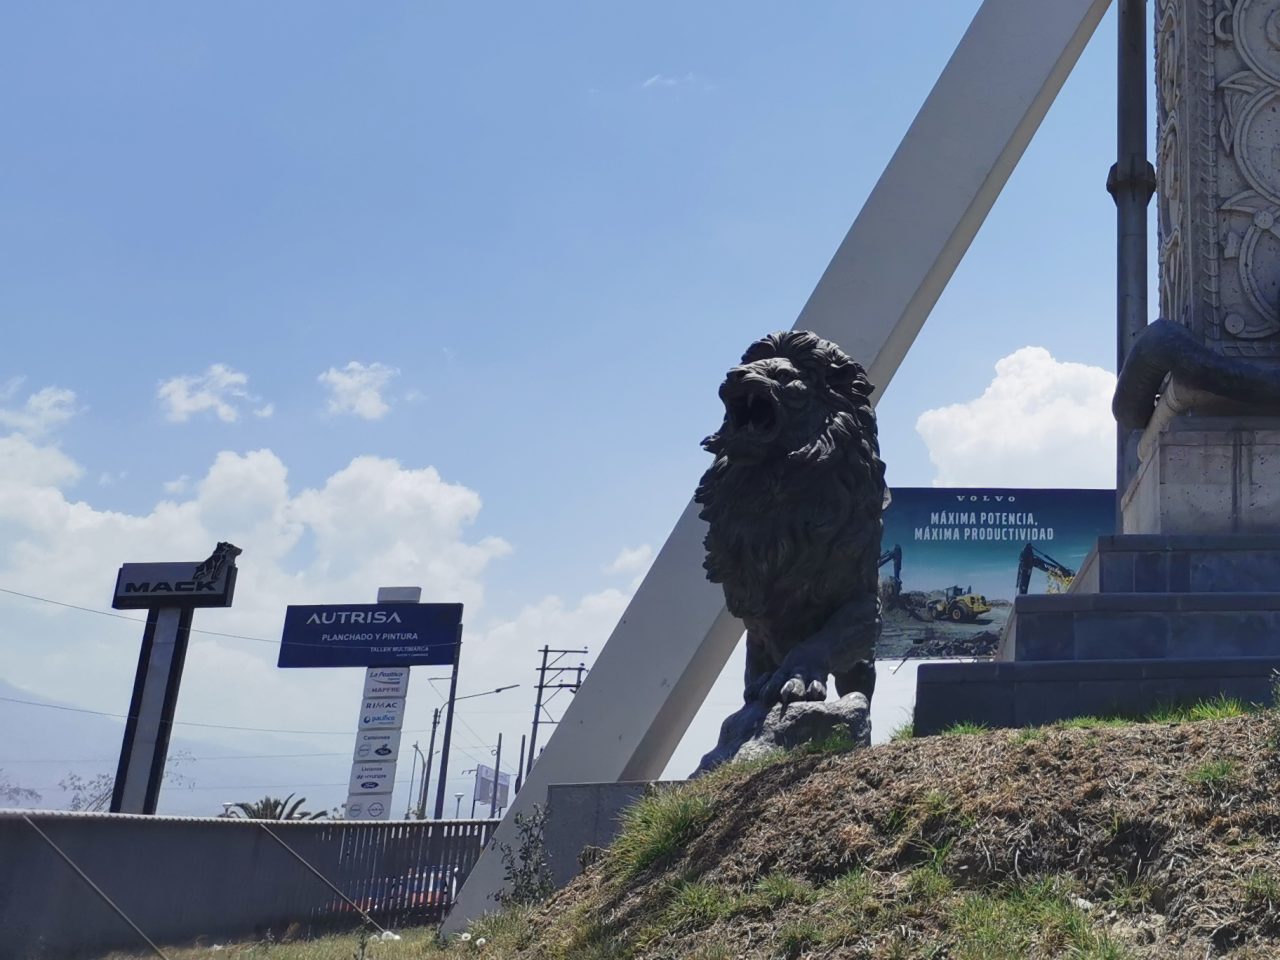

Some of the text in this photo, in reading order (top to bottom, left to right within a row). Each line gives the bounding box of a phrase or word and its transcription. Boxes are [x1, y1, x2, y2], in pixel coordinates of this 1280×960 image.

[931, 510, 976, 524] MÁXIMA
[914, 526, 1054, 540] MÁXIMA PRODUCTIVIDAD
[125, 581, 216, 592] MACK
[306, 611, 402, 624] AUTRISA
[322, 633, 373, 641] PLANCHADO
[382, 632, 418, 640] PINTURA
